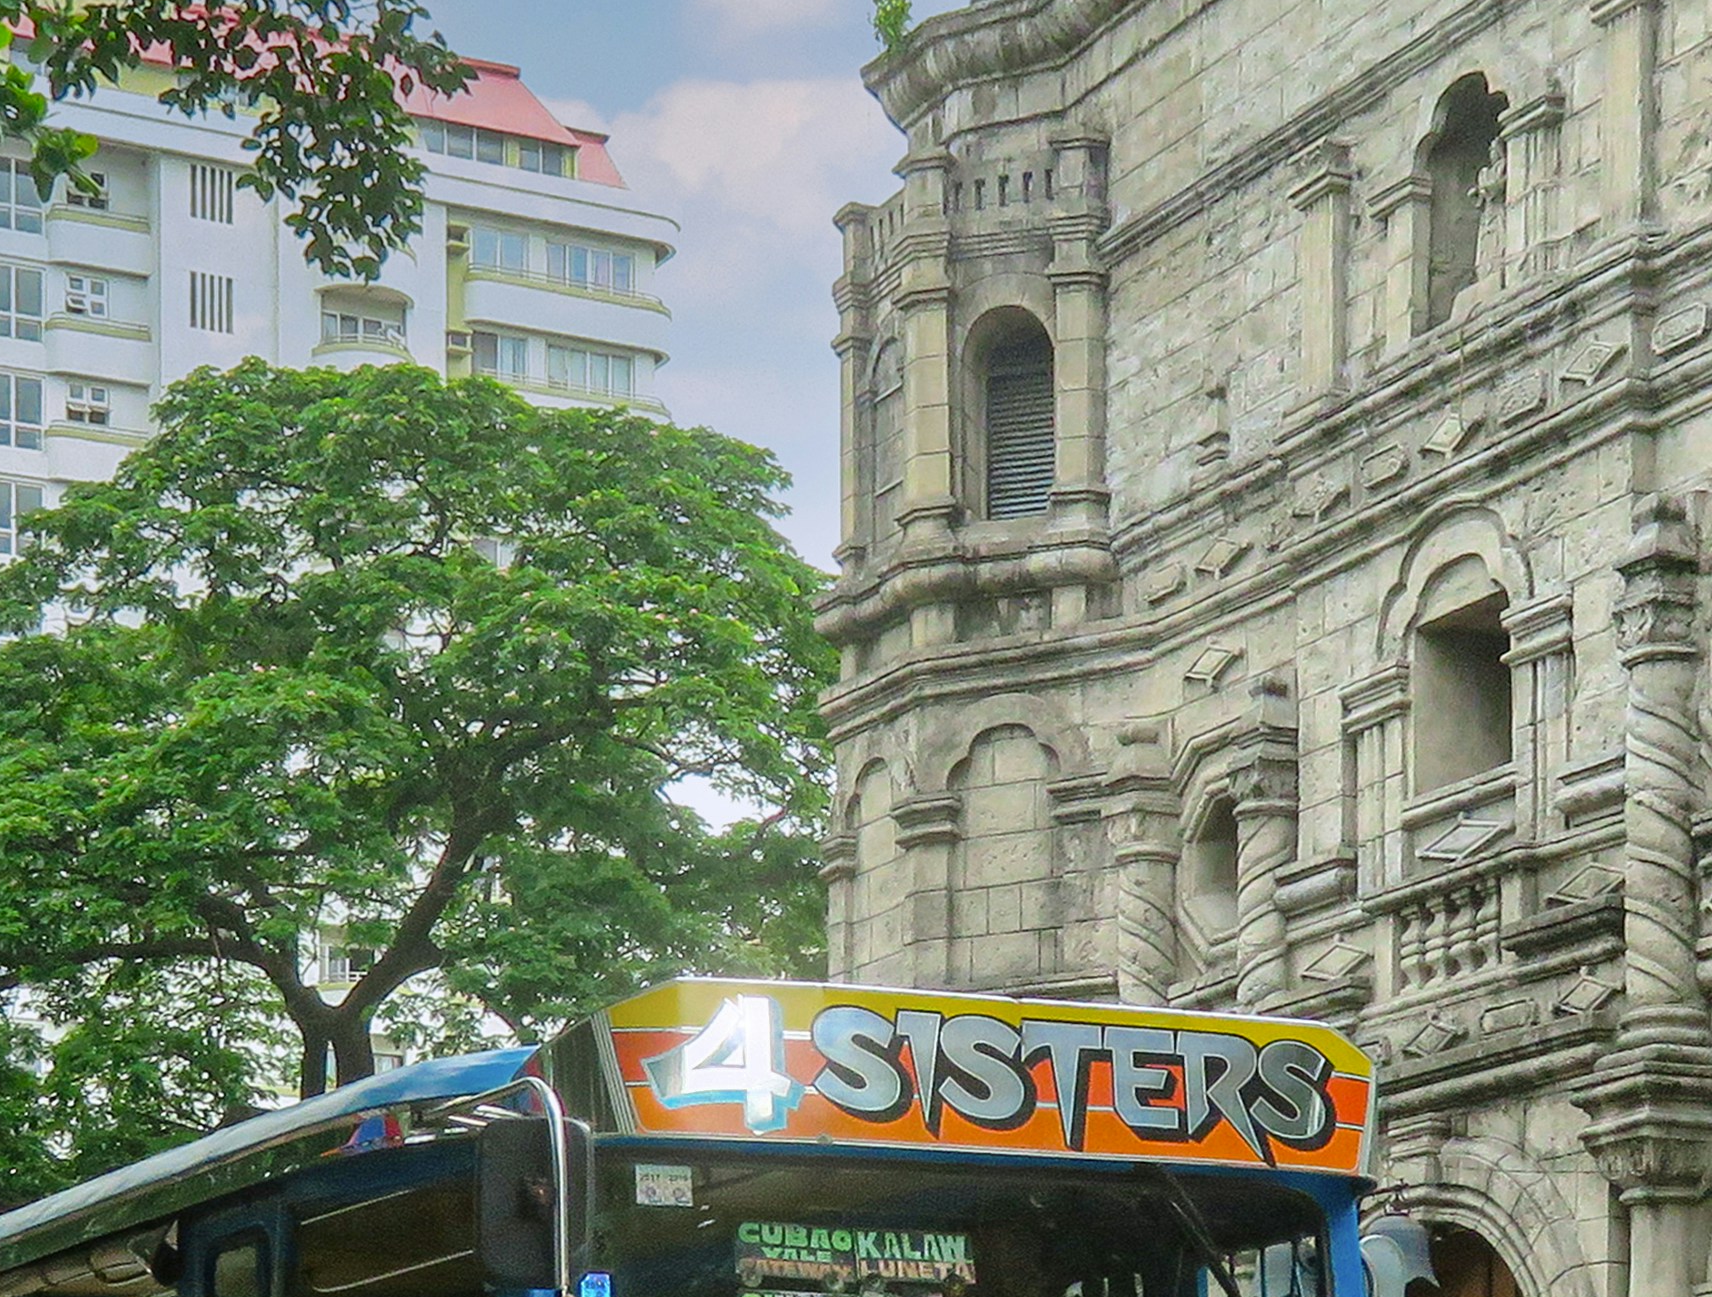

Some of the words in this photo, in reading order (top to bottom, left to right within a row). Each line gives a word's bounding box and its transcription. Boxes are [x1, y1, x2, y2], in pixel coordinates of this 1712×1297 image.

[640, 992, 806, 1136] 4
[811, 1005, 1334, 1167] SISTERS
[738, 1221, 854, 1252] CUBAO
[857, 1230, 968, 1262] KALAW
[760, 1247, 832, 1263] YALE
[859, 1259, 976, 1285] LUNETA
